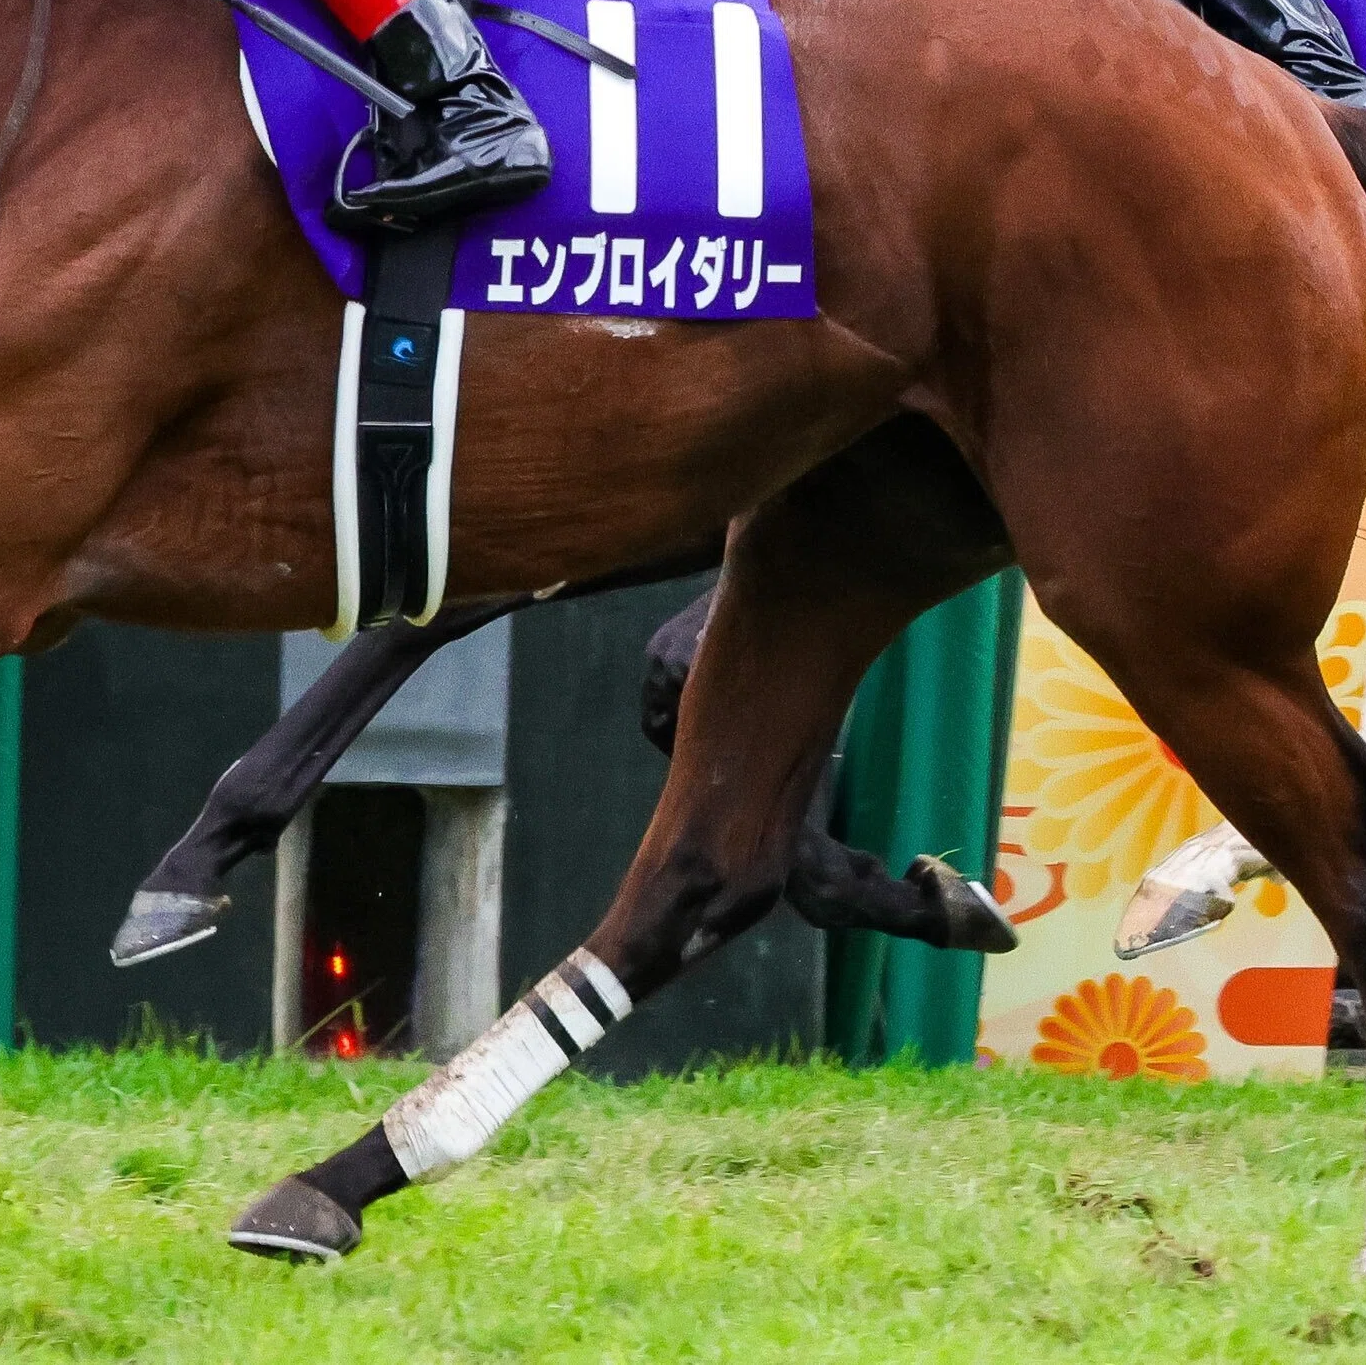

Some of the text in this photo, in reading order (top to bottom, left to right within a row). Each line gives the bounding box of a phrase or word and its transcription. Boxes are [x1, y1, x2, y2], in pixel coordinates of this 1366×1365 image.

[487, 231, 802, 310] エンブロイダリー
